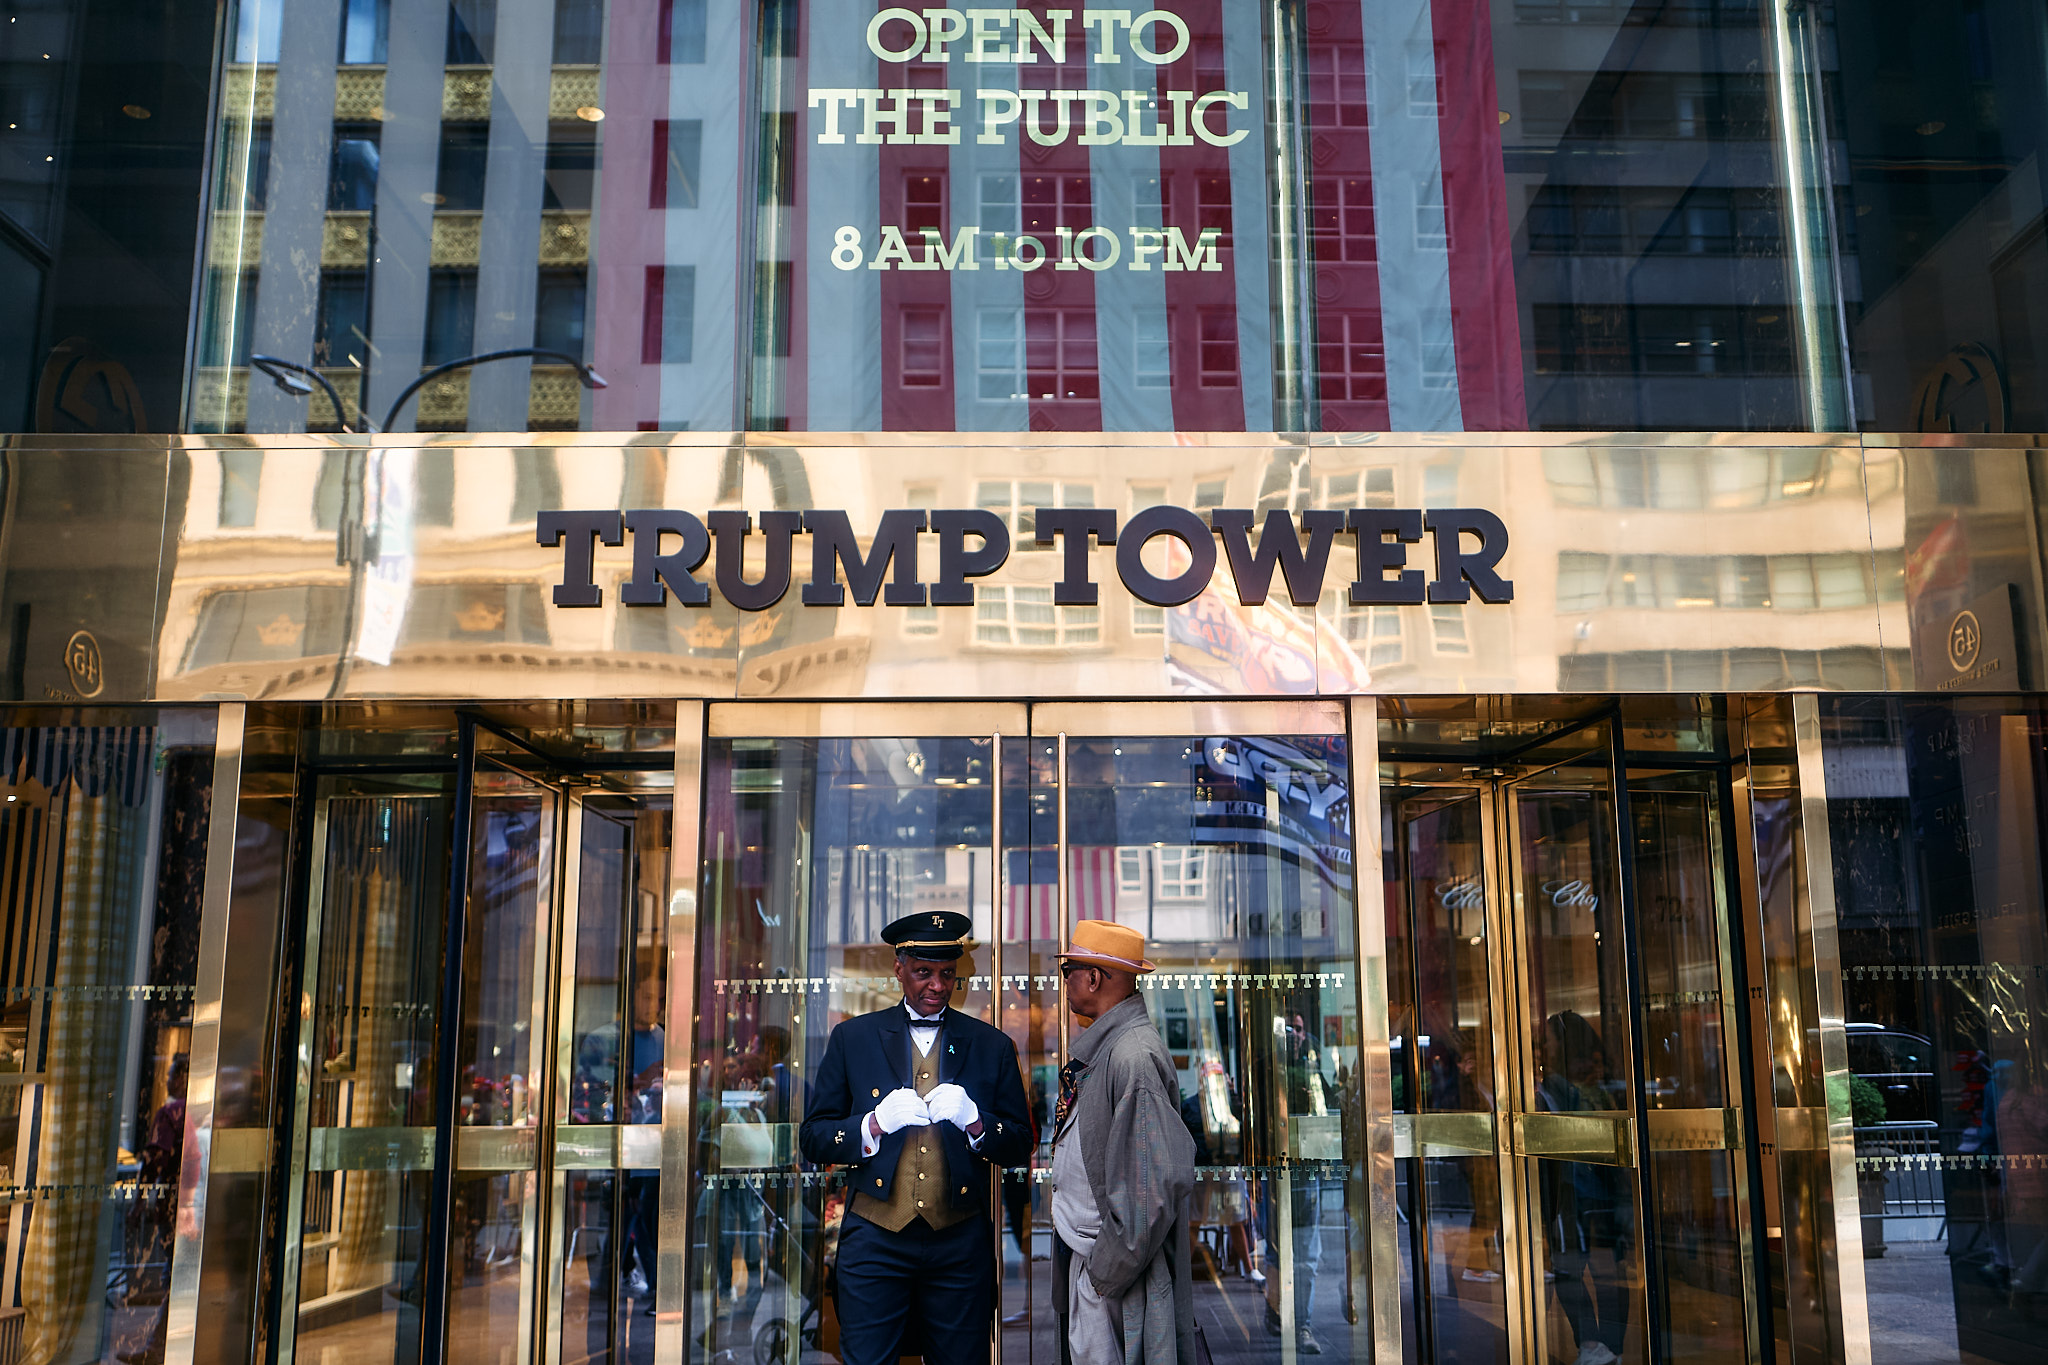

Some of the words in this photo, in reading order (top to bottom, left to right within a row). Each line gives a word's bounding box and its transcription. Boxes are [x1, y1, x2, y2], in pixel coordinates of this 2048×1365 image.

[866, 7, 1072, 64] OPEN
[1083, 9, 1190, 64] TO
[808, 89, 961, 145] THE
[976, 89, 1250, 147] PUBLIC
[830, 226, 864, 271] 8
[868, 226, 979, 271] AM
[990, 235, 1046, 272] to
[1128, 226, 1224, 272] PM
[536, 509, 1011, 611] TRUMP
[1034, 505, 1514, 607] TOWER
